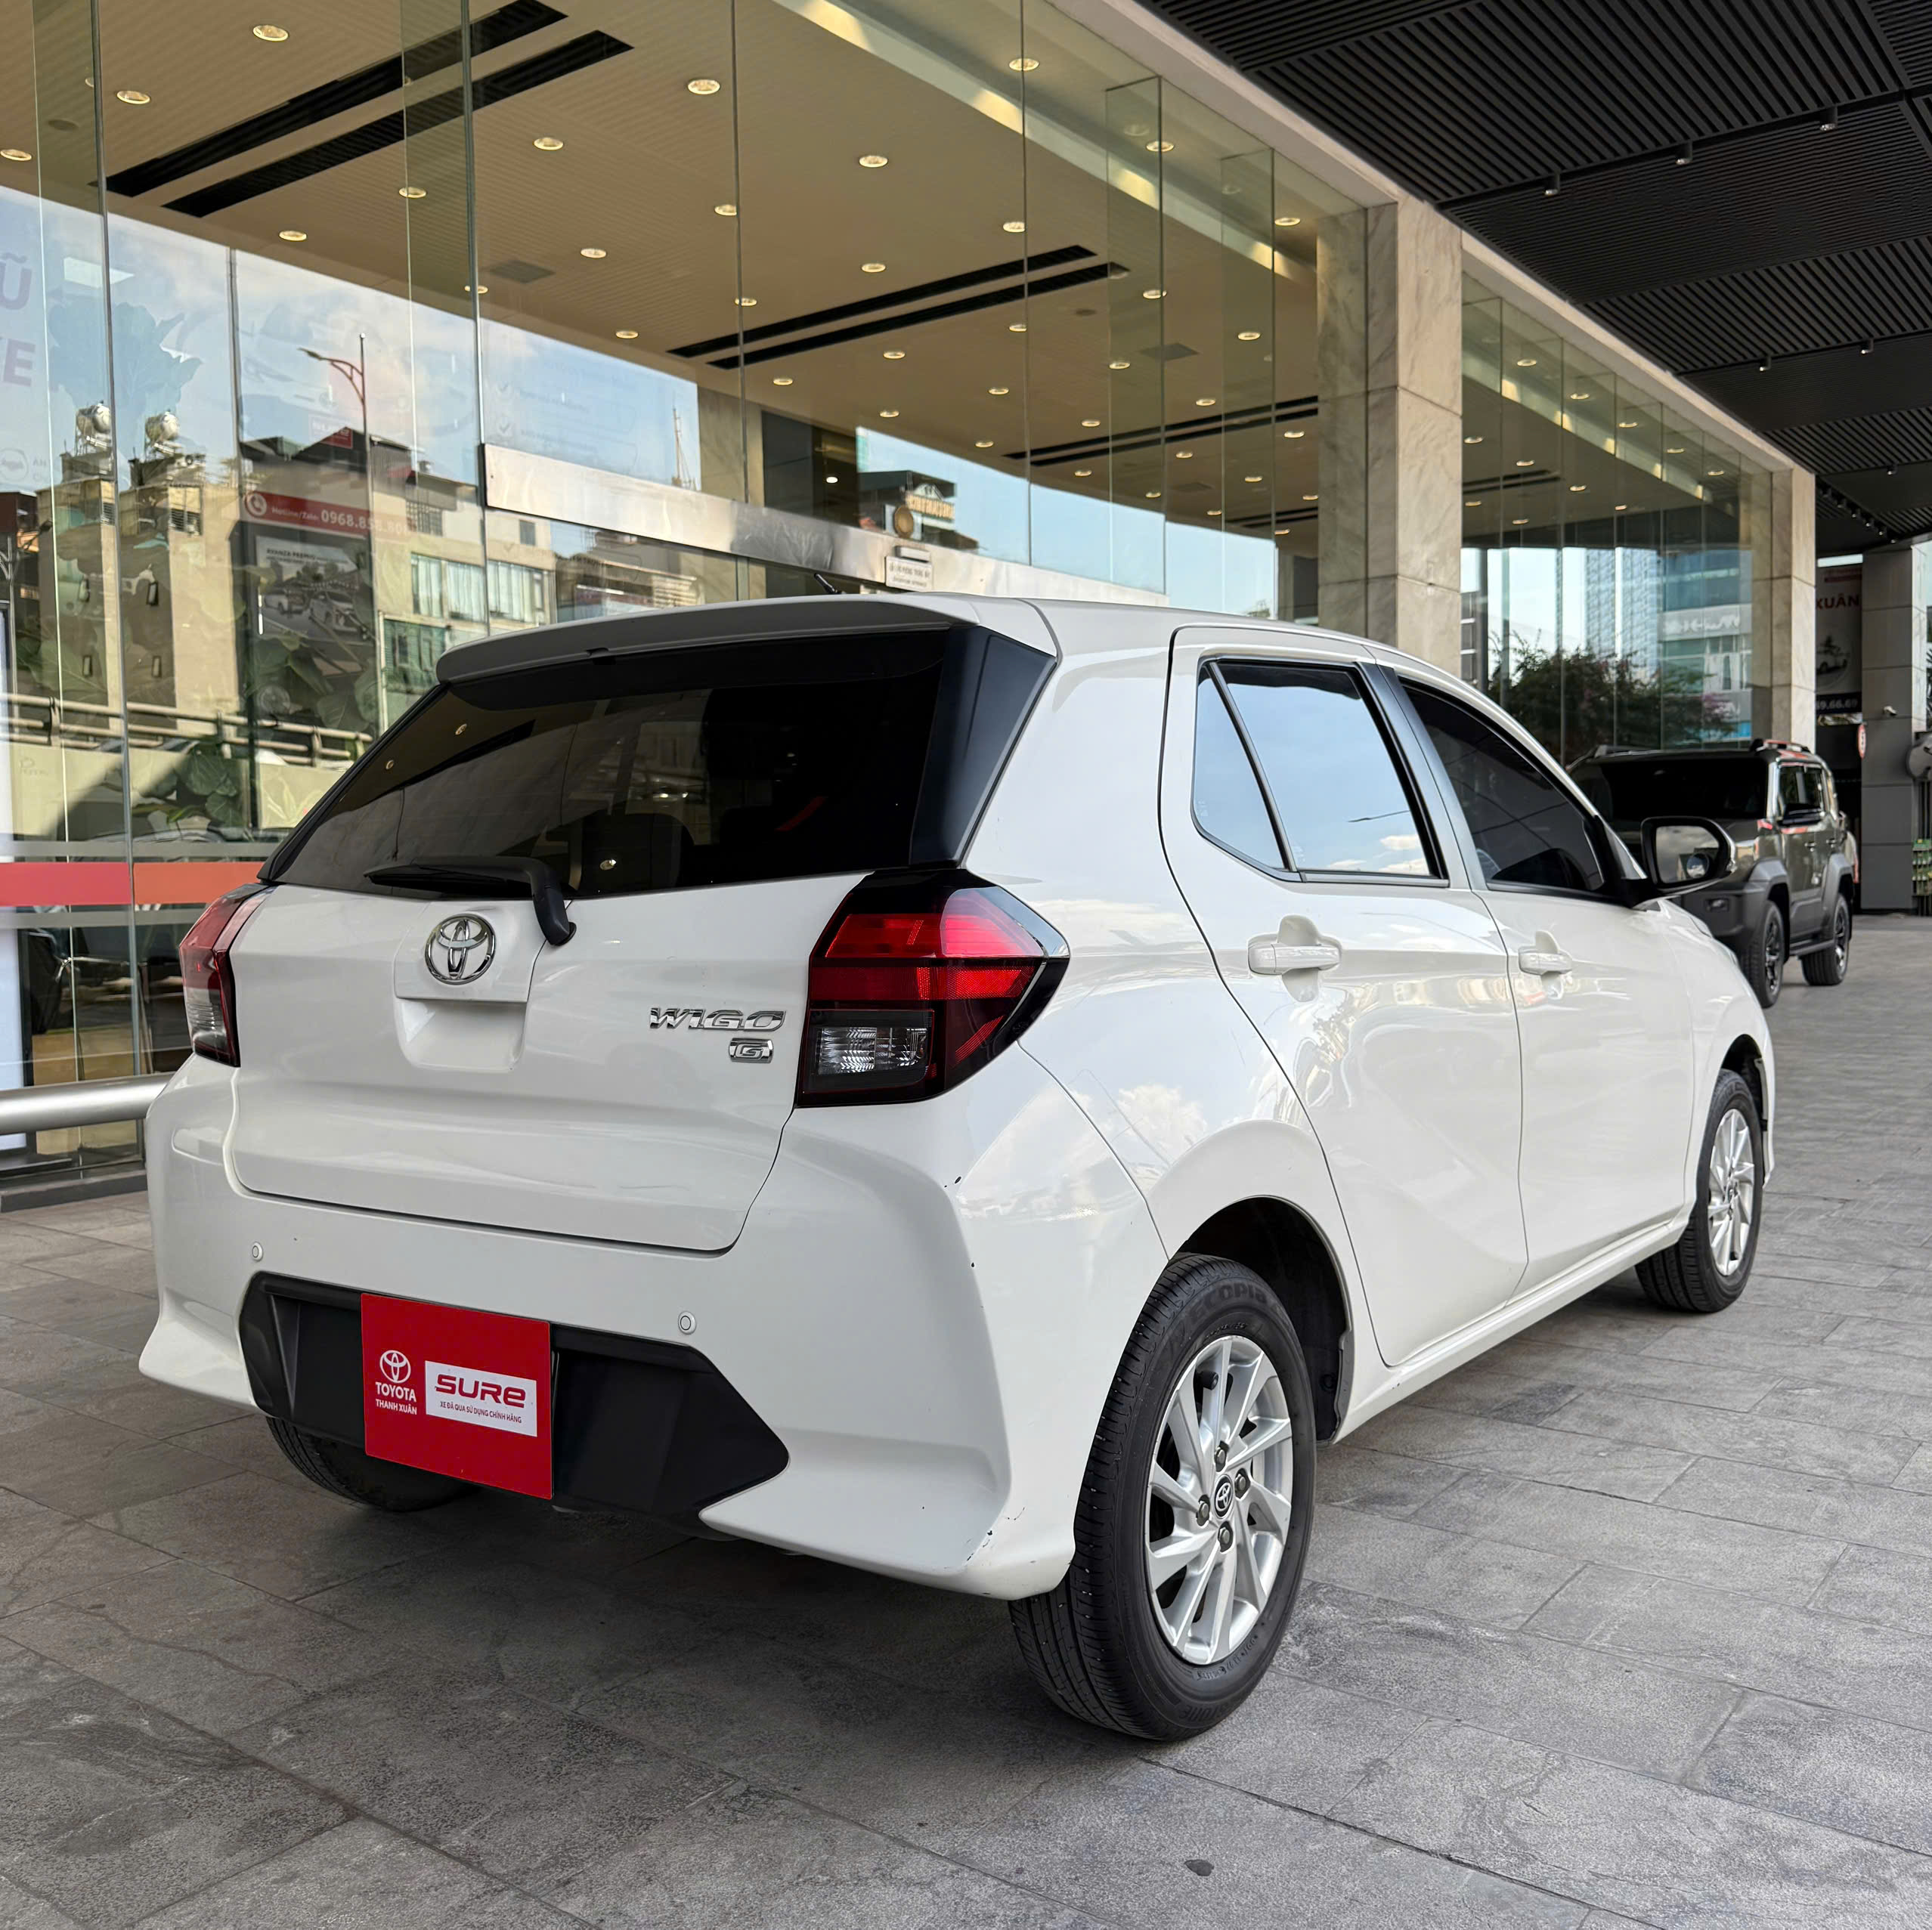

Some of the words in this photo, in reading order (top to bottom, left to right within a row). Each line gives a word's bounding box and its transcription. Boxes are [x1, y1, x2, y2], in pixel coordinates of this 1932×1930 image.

[650, 1007, 786, 1031] WIGO
[732, 1040, 766, 1061] G
[376, 1381, 416, 1403] TOYOTA
[376, 1399, 398, 1411] THANH
[399, 1401, 417, 1415] XUÂN
[455, 1404, 466, 1412] QUA
[474, 1408, 488, 1417] DỤNG
[490, 1410, 506, 1420] CHÍNH
